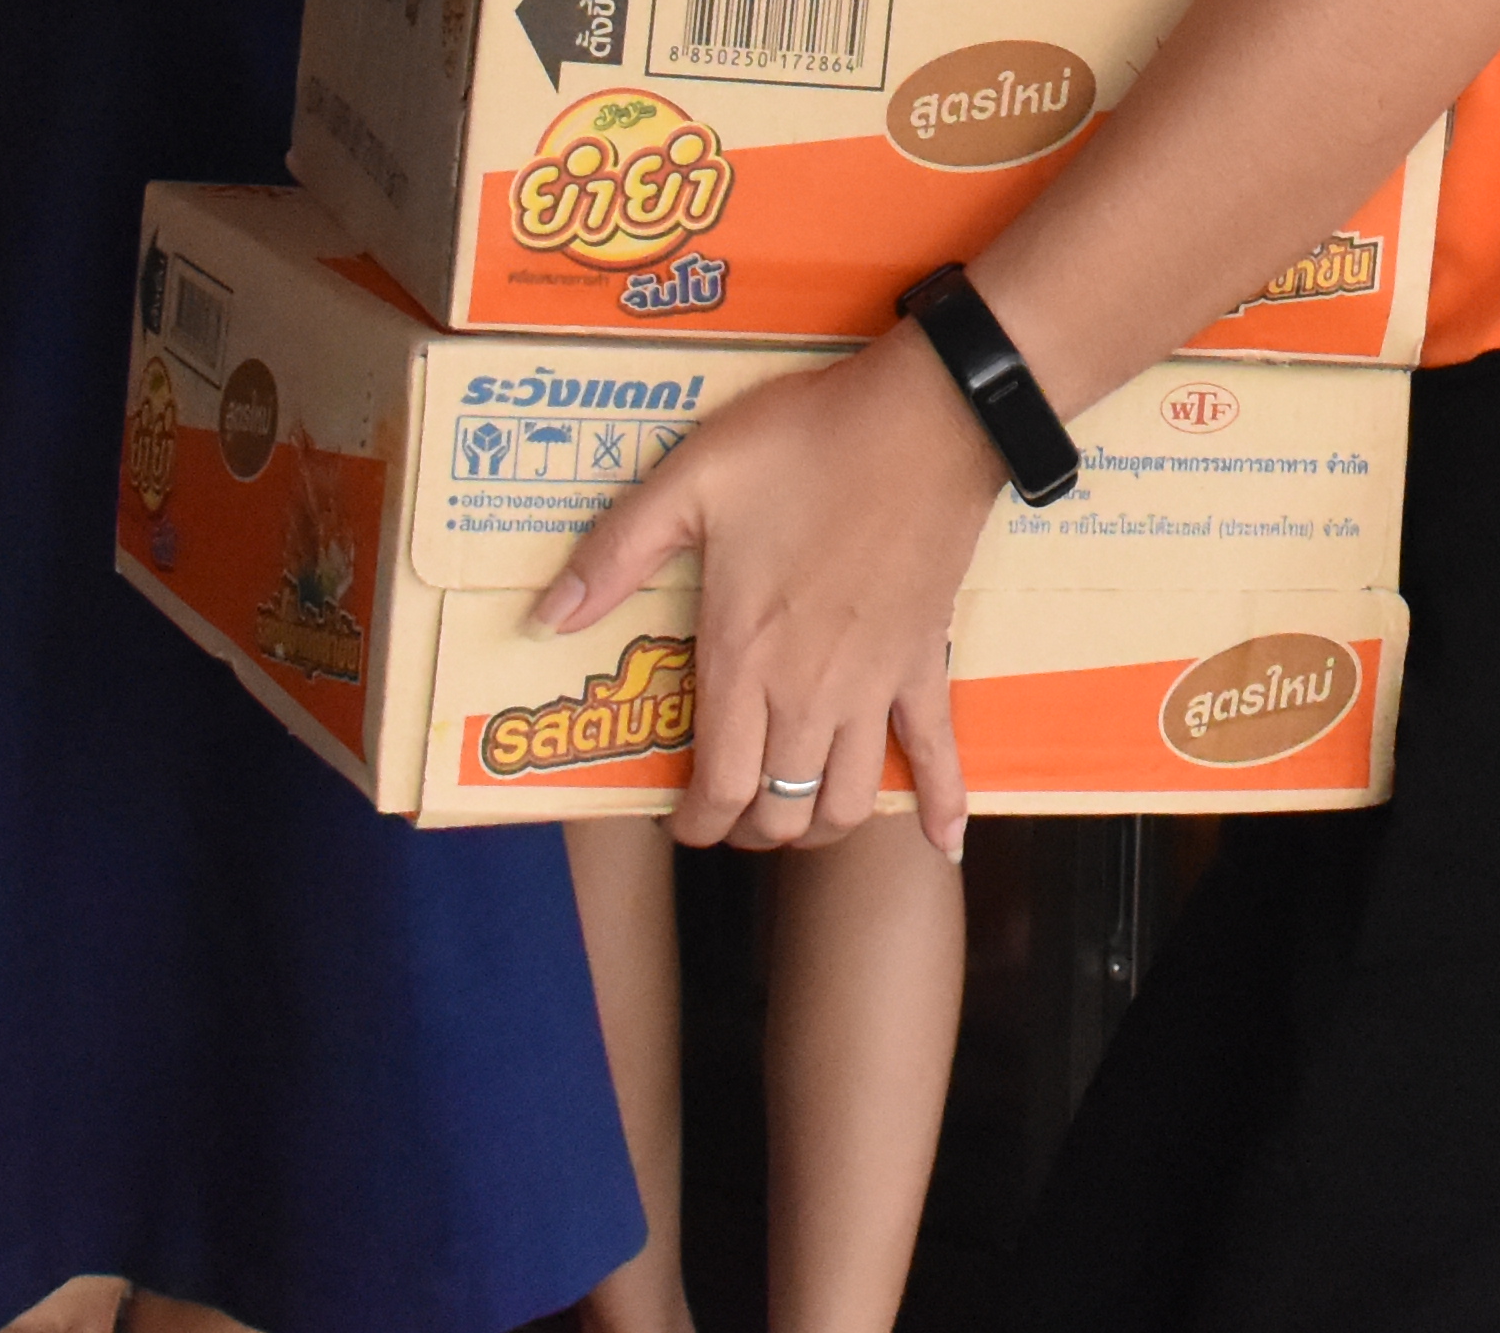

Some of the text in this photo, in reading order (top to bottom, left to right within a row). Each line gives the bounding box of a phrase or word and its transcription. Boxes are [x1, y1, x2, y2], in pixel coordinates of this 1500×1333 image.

[909, 66, 1072, 140] สูตรใหม่
[512, 123, 733, 247] ยำยำ
[620, 252, 727, 311] จัมโบ้
[461, 366, 705, 411] ระวังแตก!
[1169, 390, 1232, 426] WTF
[1326, 452, 1369, 476] จำกัด
[1008, 514, 1052, 535] บริษัท
[1219, 515, 1315, 540] (ประเทศไทย)
[1322, 518, 1361, 539] จำกัด
[1184, 656, 1335, 738] สูตรใหม่
